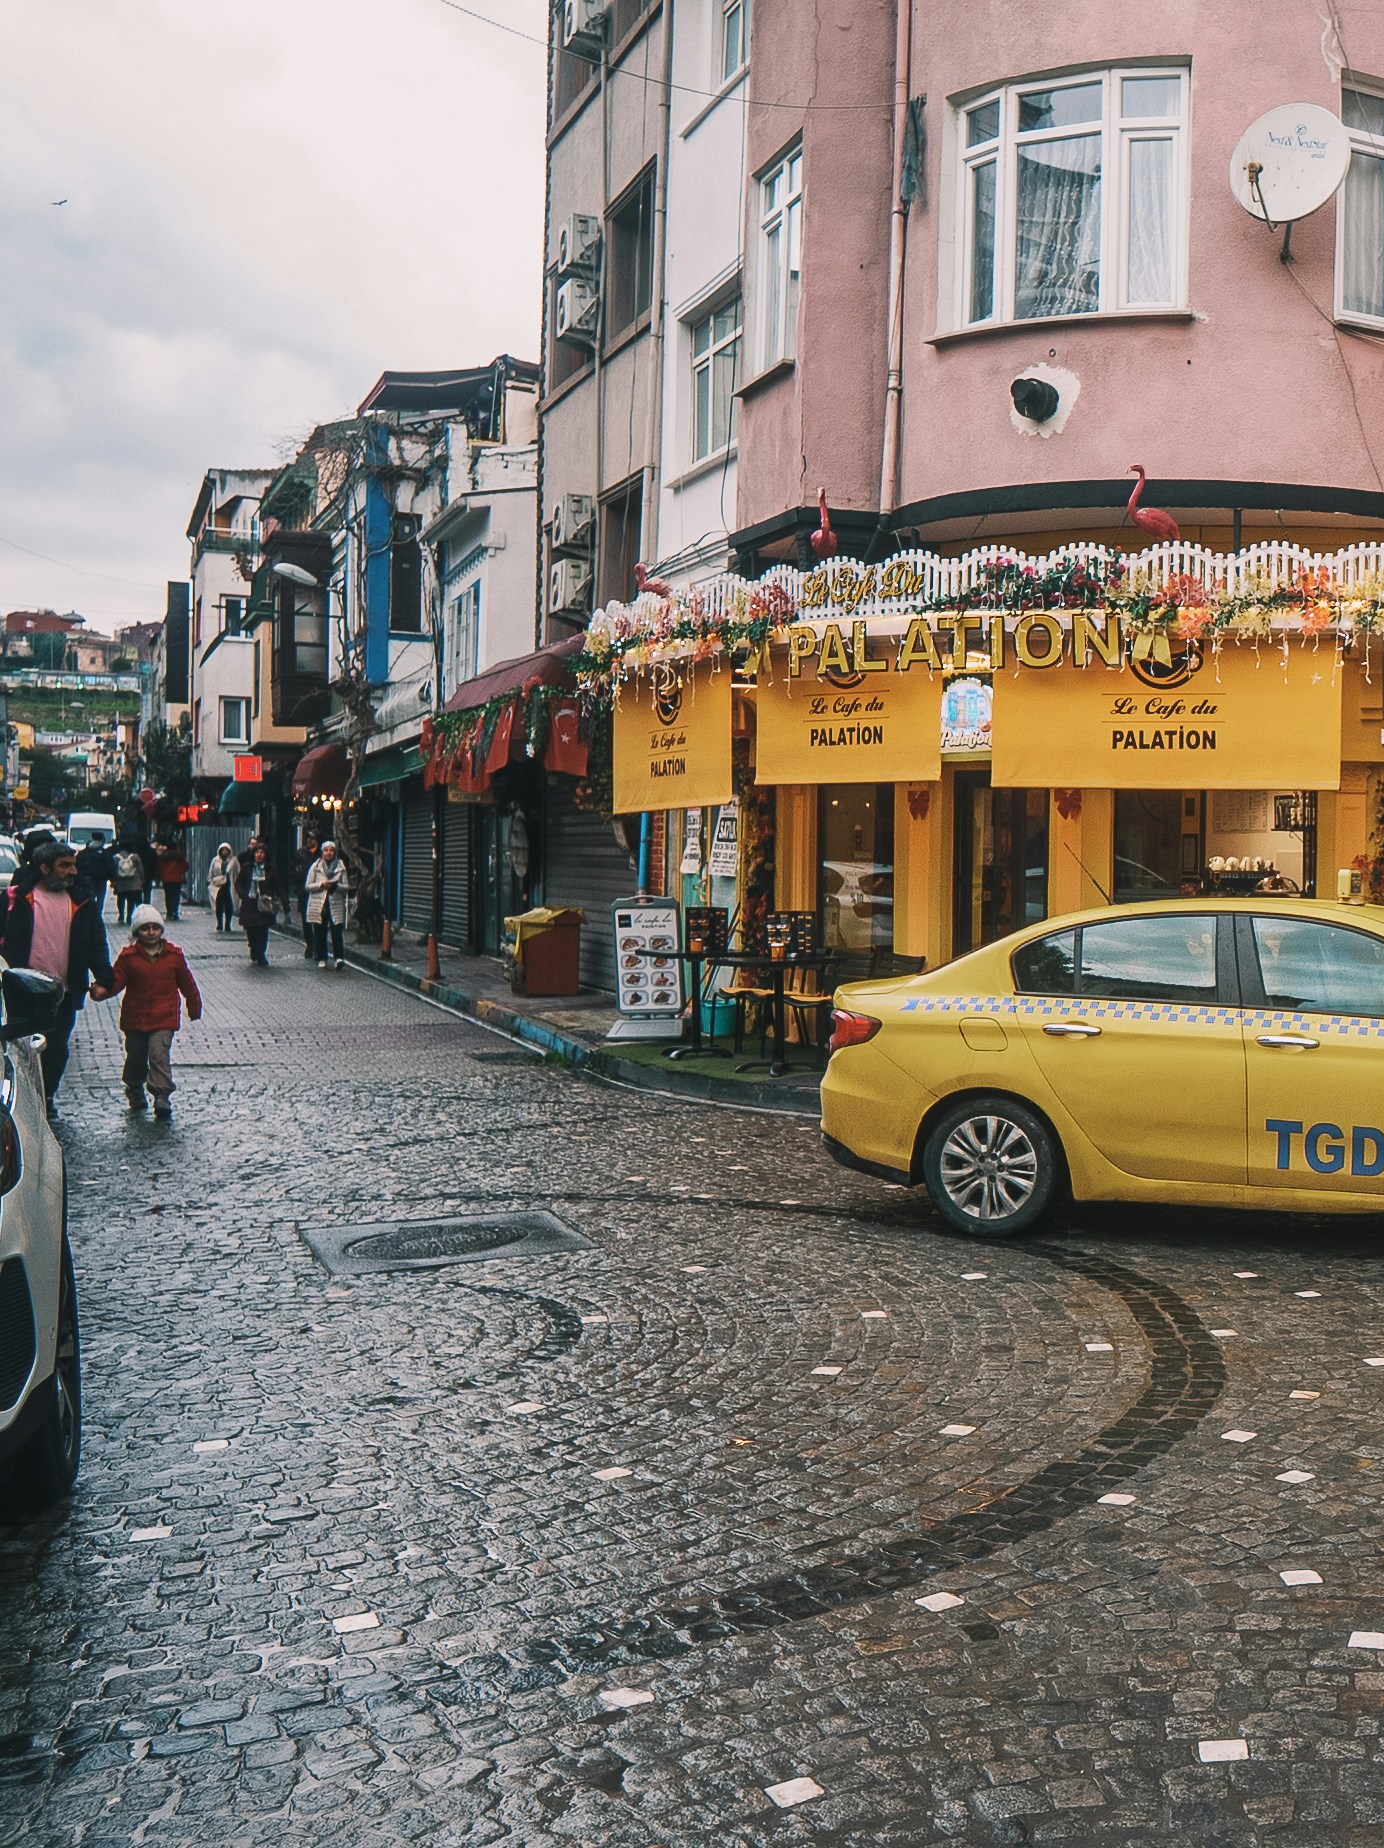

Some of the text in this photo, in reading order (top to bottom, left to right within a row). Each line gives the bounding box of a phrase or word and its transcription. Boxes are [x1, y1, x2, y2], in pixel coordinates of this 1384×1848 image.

[878, 561, 925, 598] Du
[788, 613, 1124, 678] PALATION
[809, 696, 885, 717] Le Cafe du
[1110, 697, 1219, 720] Le Cafe du
[810, 722, 883, 747] PALATİON
[1112, 725, 1217, 750] PALATİON
